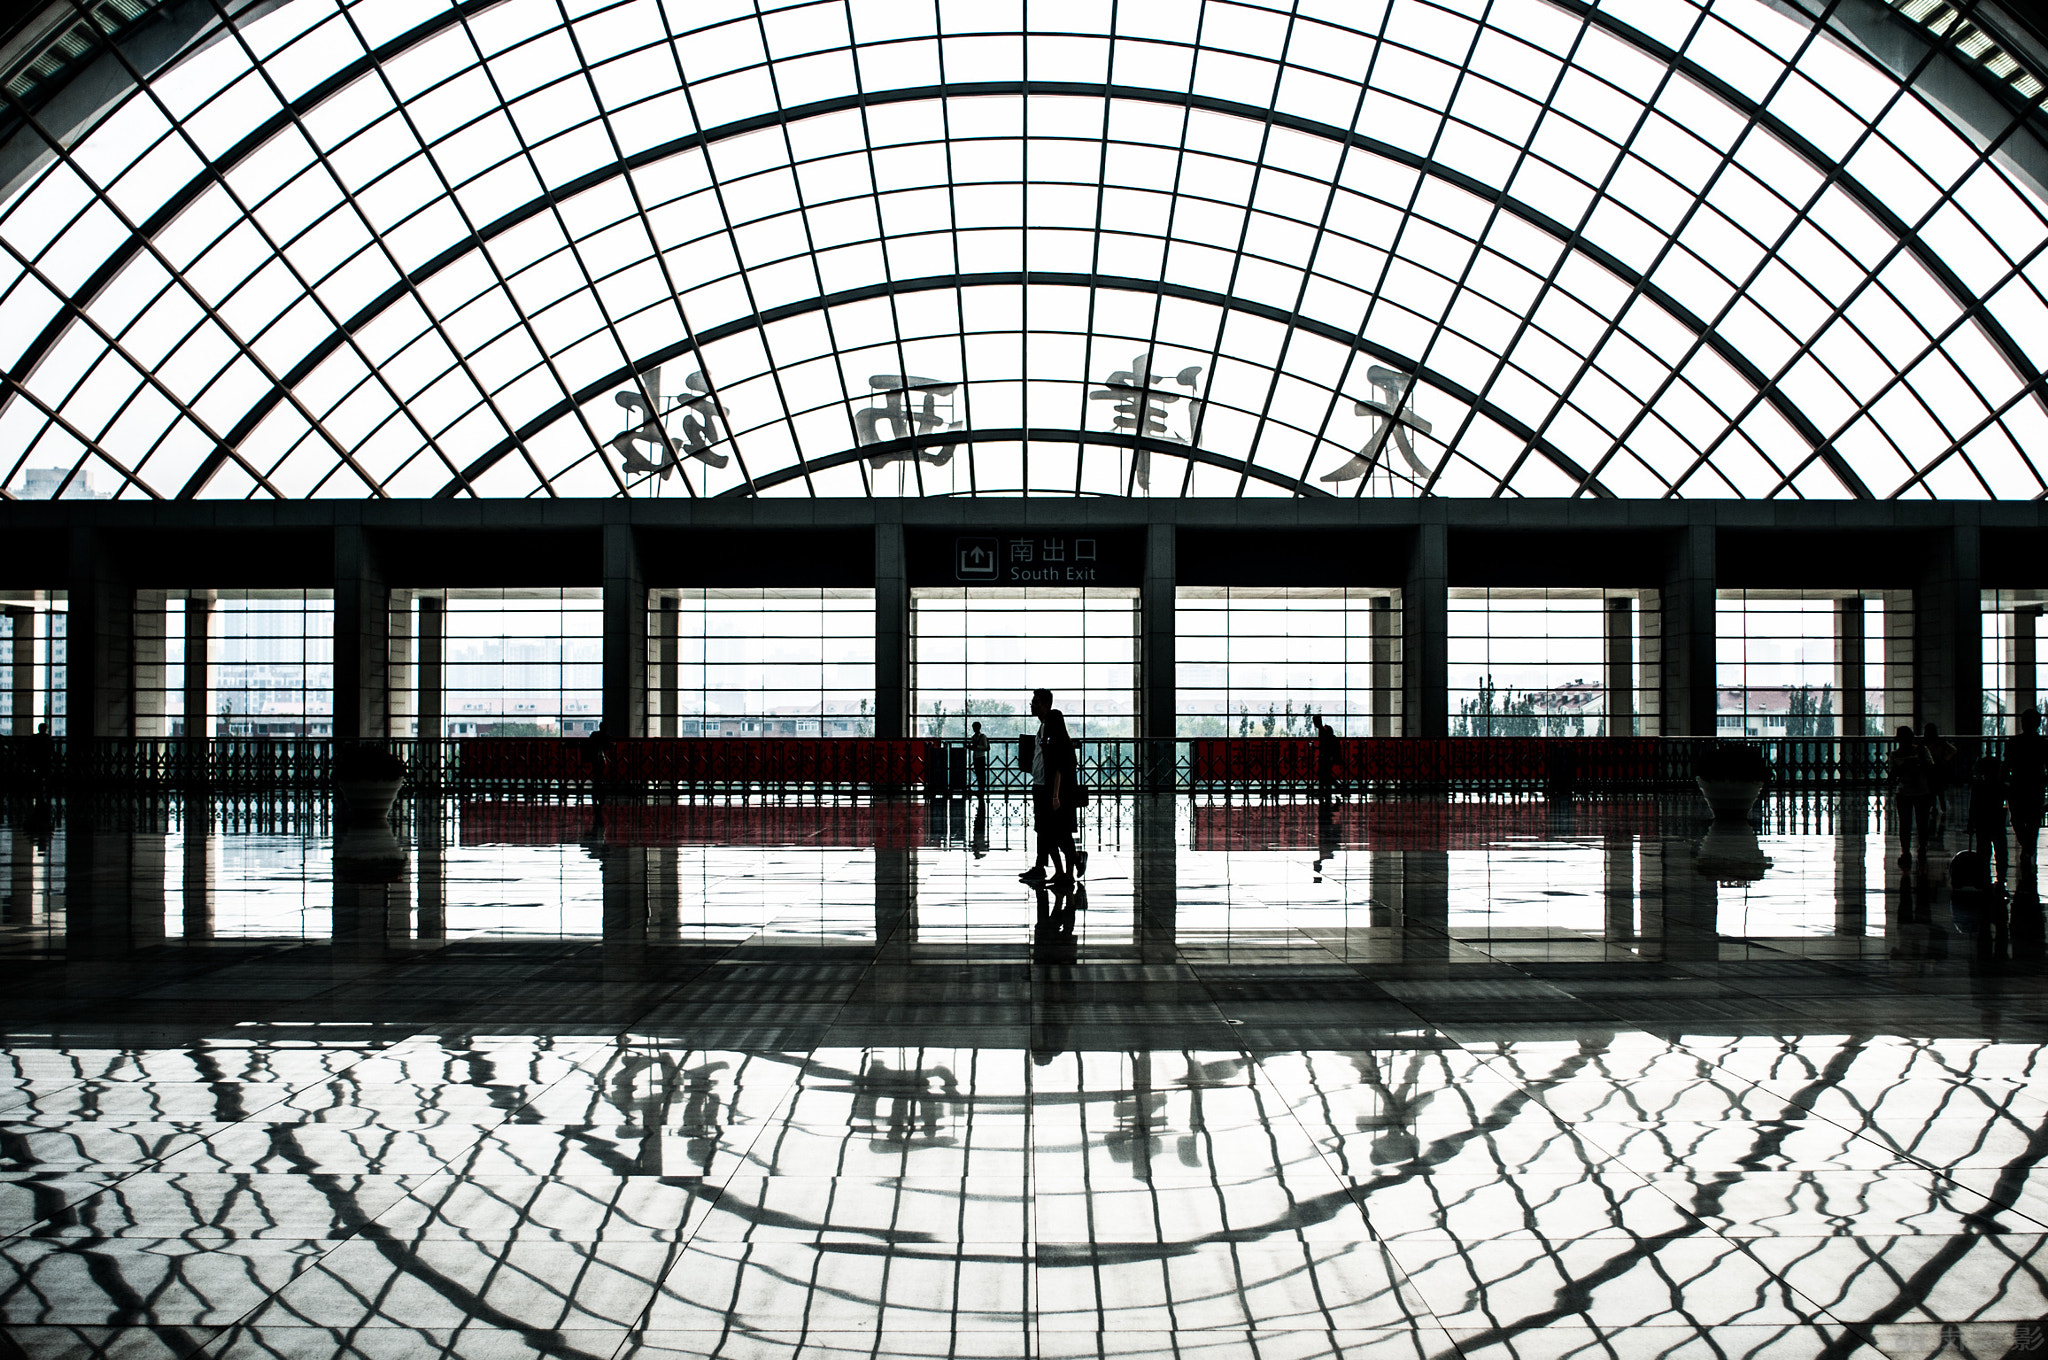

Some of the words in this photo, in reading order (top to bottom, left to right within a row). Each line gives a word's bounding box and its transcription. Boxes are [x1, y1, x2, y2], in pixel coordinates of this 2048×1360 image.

[1009, 537, 1097, 562] 南出口
[1011, 566, 1059, 581] South
[1066, 566, 1096, 581] Exit
